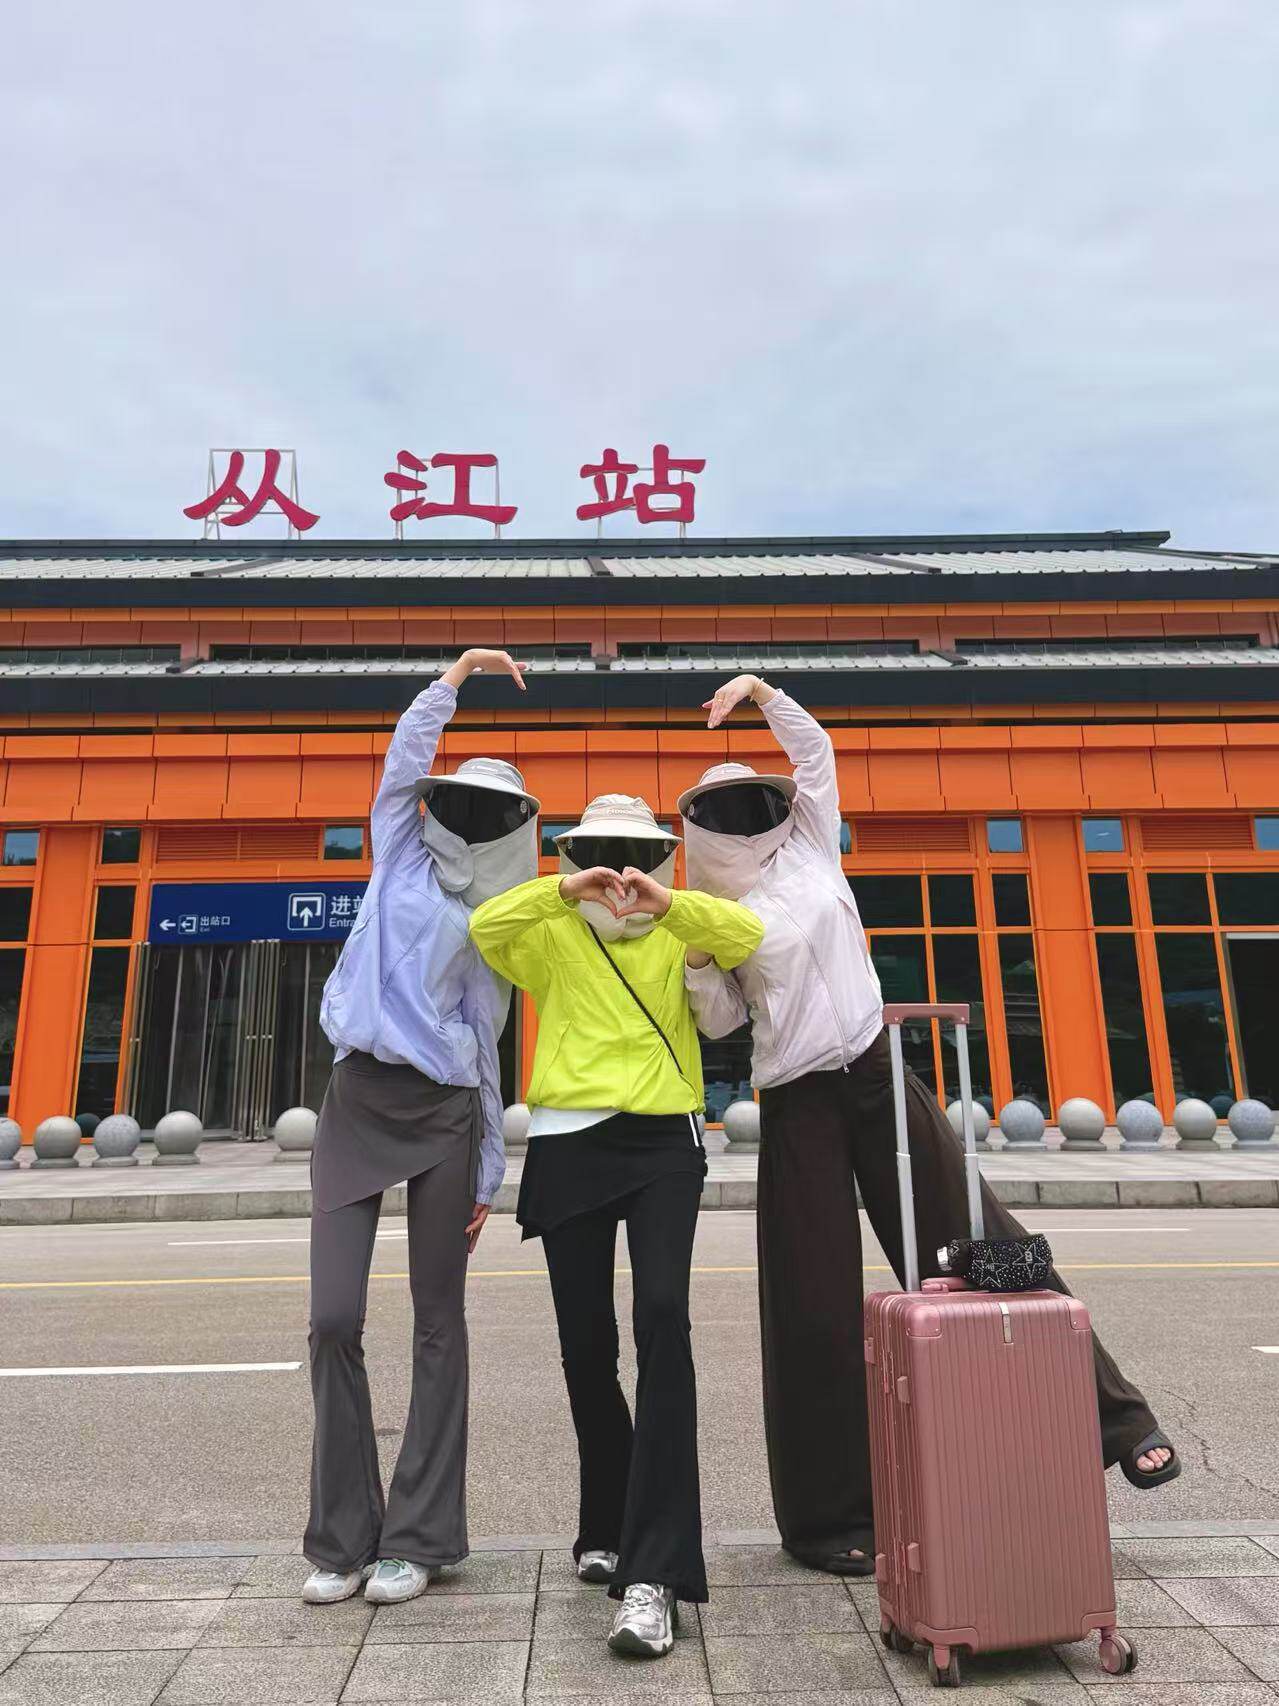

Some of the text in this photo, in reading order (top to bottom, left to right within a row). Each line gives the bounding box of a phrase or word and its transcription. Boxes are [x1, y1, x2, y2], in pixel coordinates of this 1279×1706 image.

[184, 444, 706, 531] 从江站
[200, 915, 231, 926] 出站口
